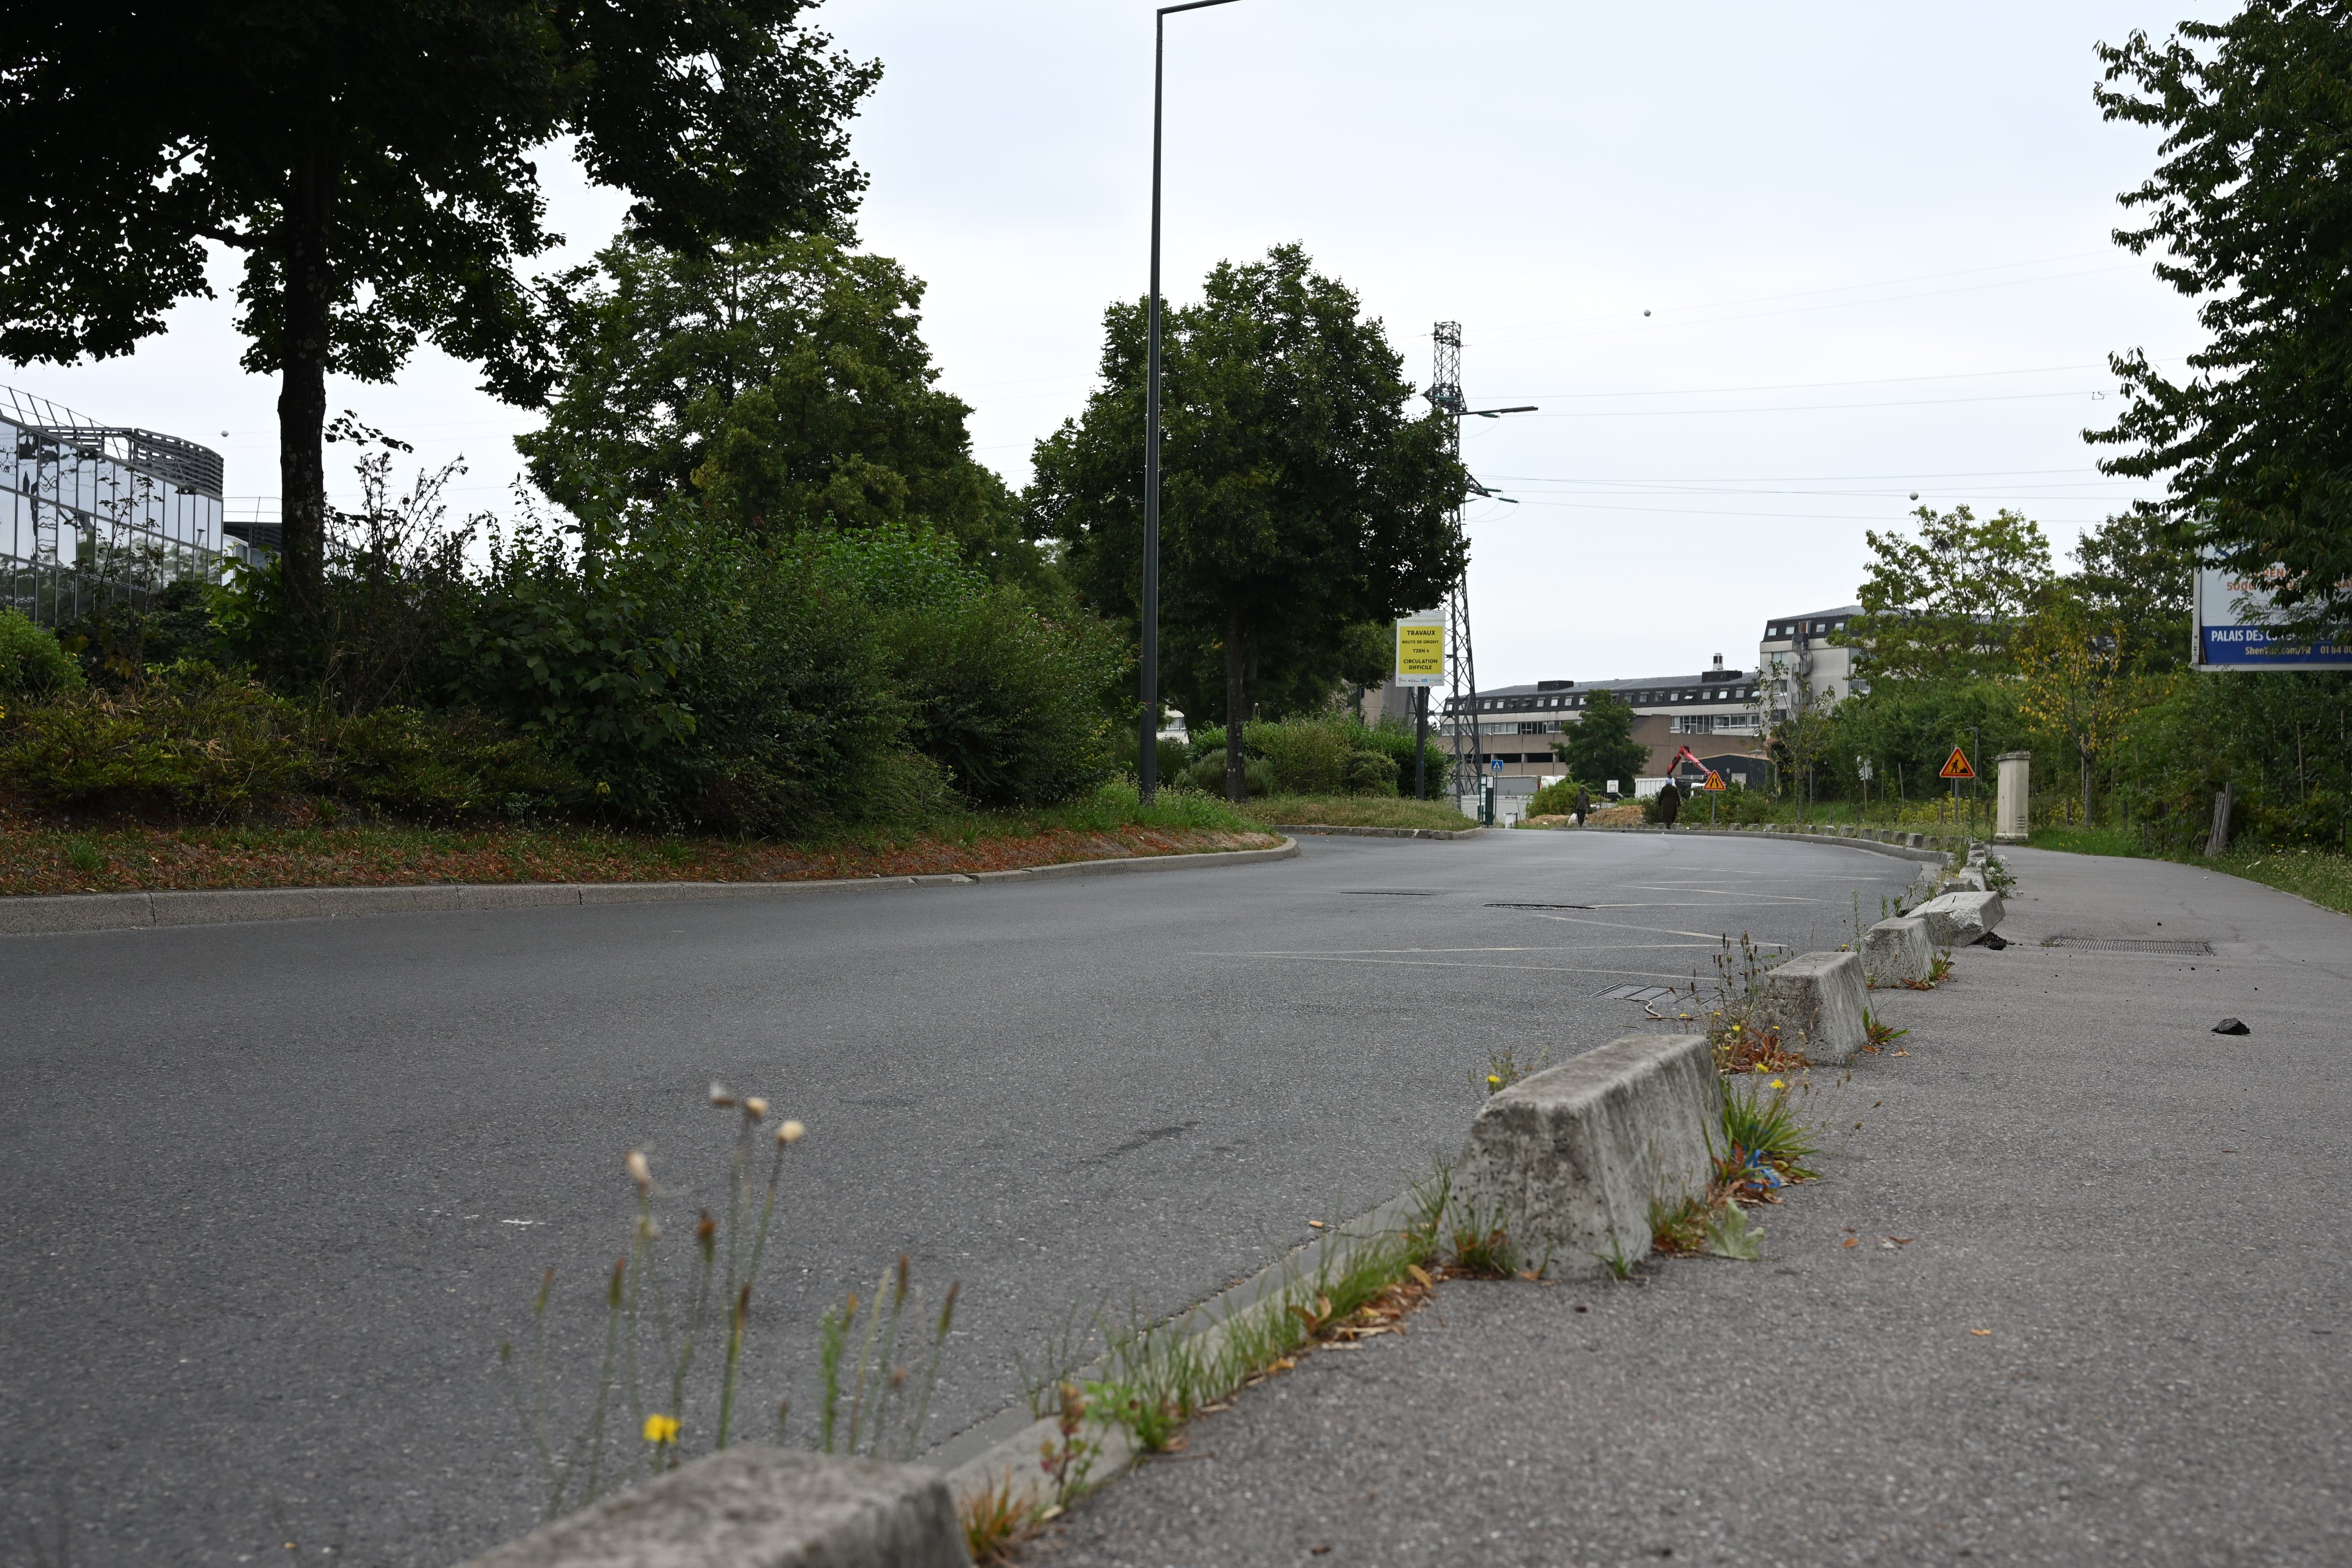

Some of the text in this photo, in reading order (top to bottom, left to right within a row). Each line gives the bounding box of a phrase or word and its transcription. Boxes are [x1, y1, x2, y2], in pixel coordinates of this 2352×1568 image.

[2211, 630, 2243, 642] PALAIS
[2246, 630, 2264, 641] DES
[2320, 645, 2329, 654] 01
[2331, 645, 2341, 654] 84
